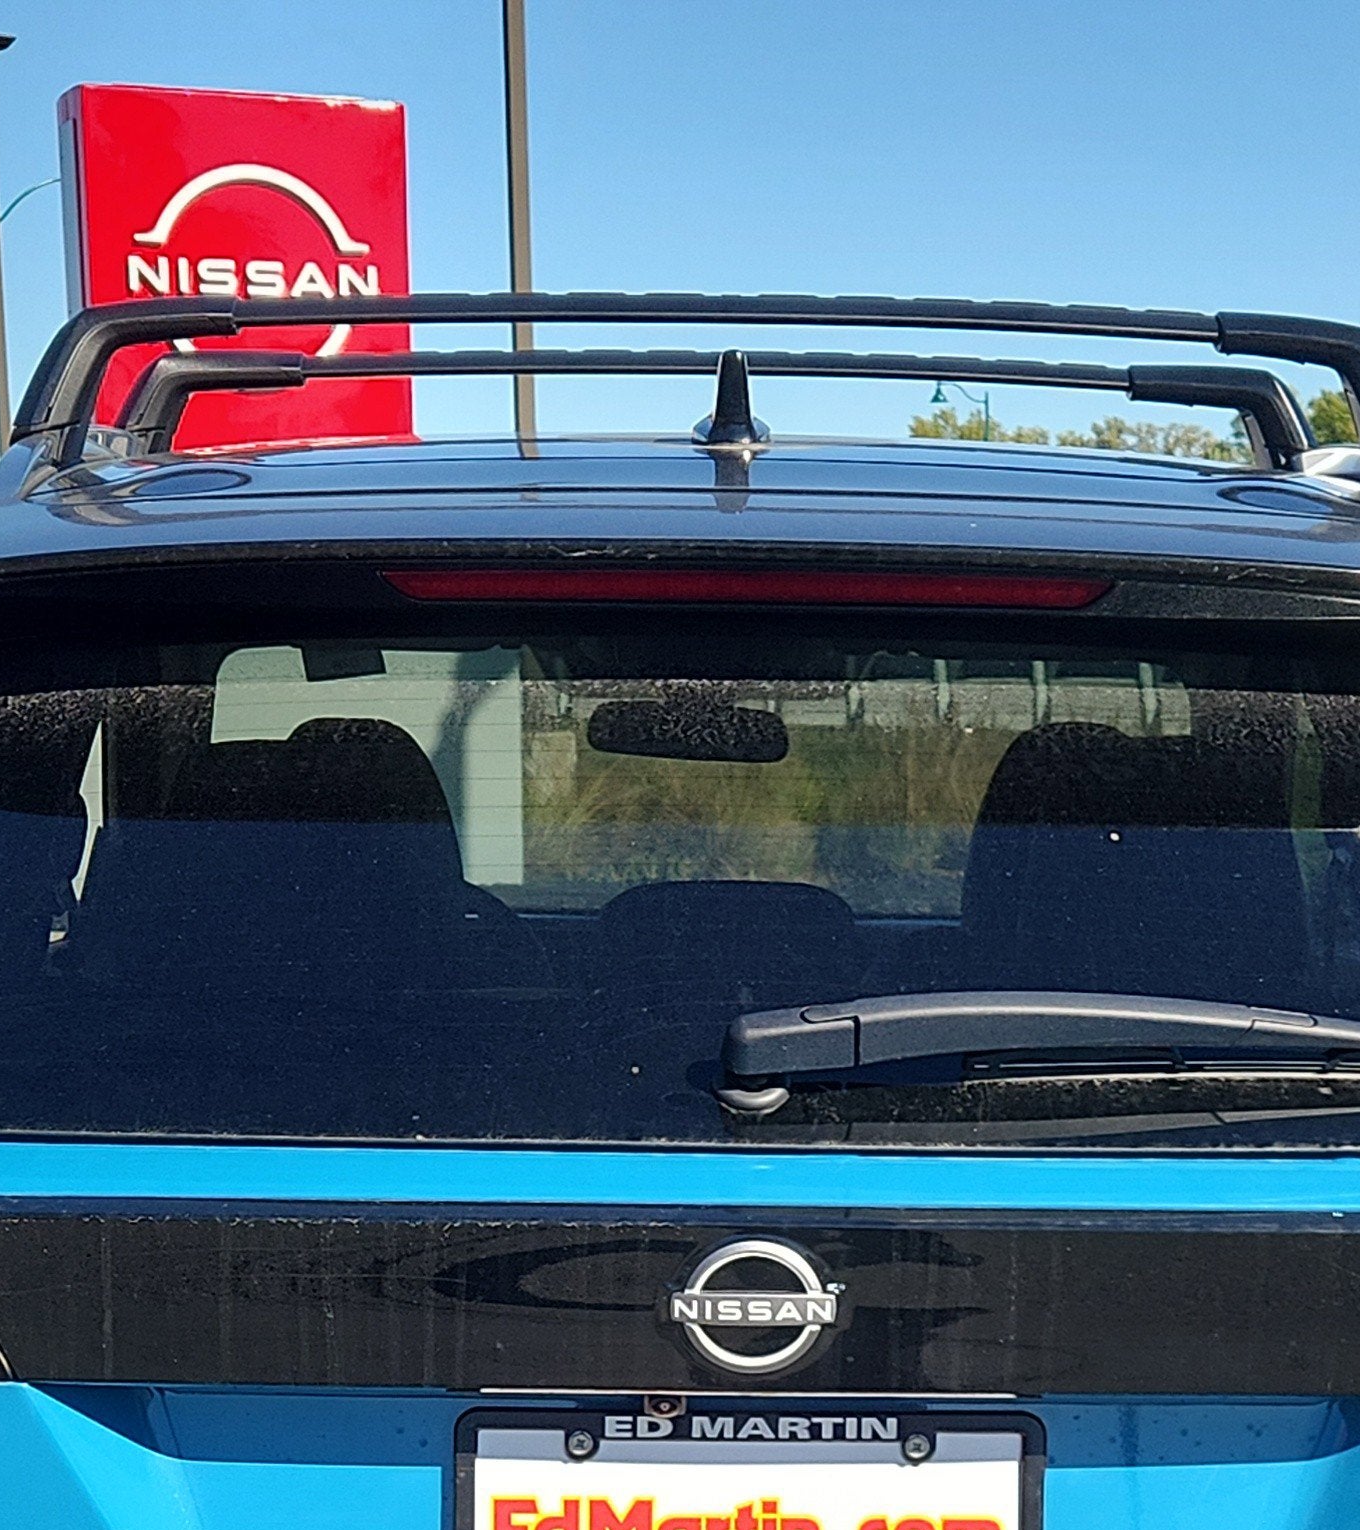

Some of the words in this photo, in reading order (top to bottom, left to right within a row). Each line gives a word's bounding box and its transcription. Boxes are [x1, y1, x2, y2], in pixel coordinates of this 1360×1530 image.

[127, 254, 379, 299] NISSAN
[673, 1298, 833, 1323] NISSAN
[604, 1415, 674, 1438] ED
[691, 1416, 898, 1440] MARTIN
